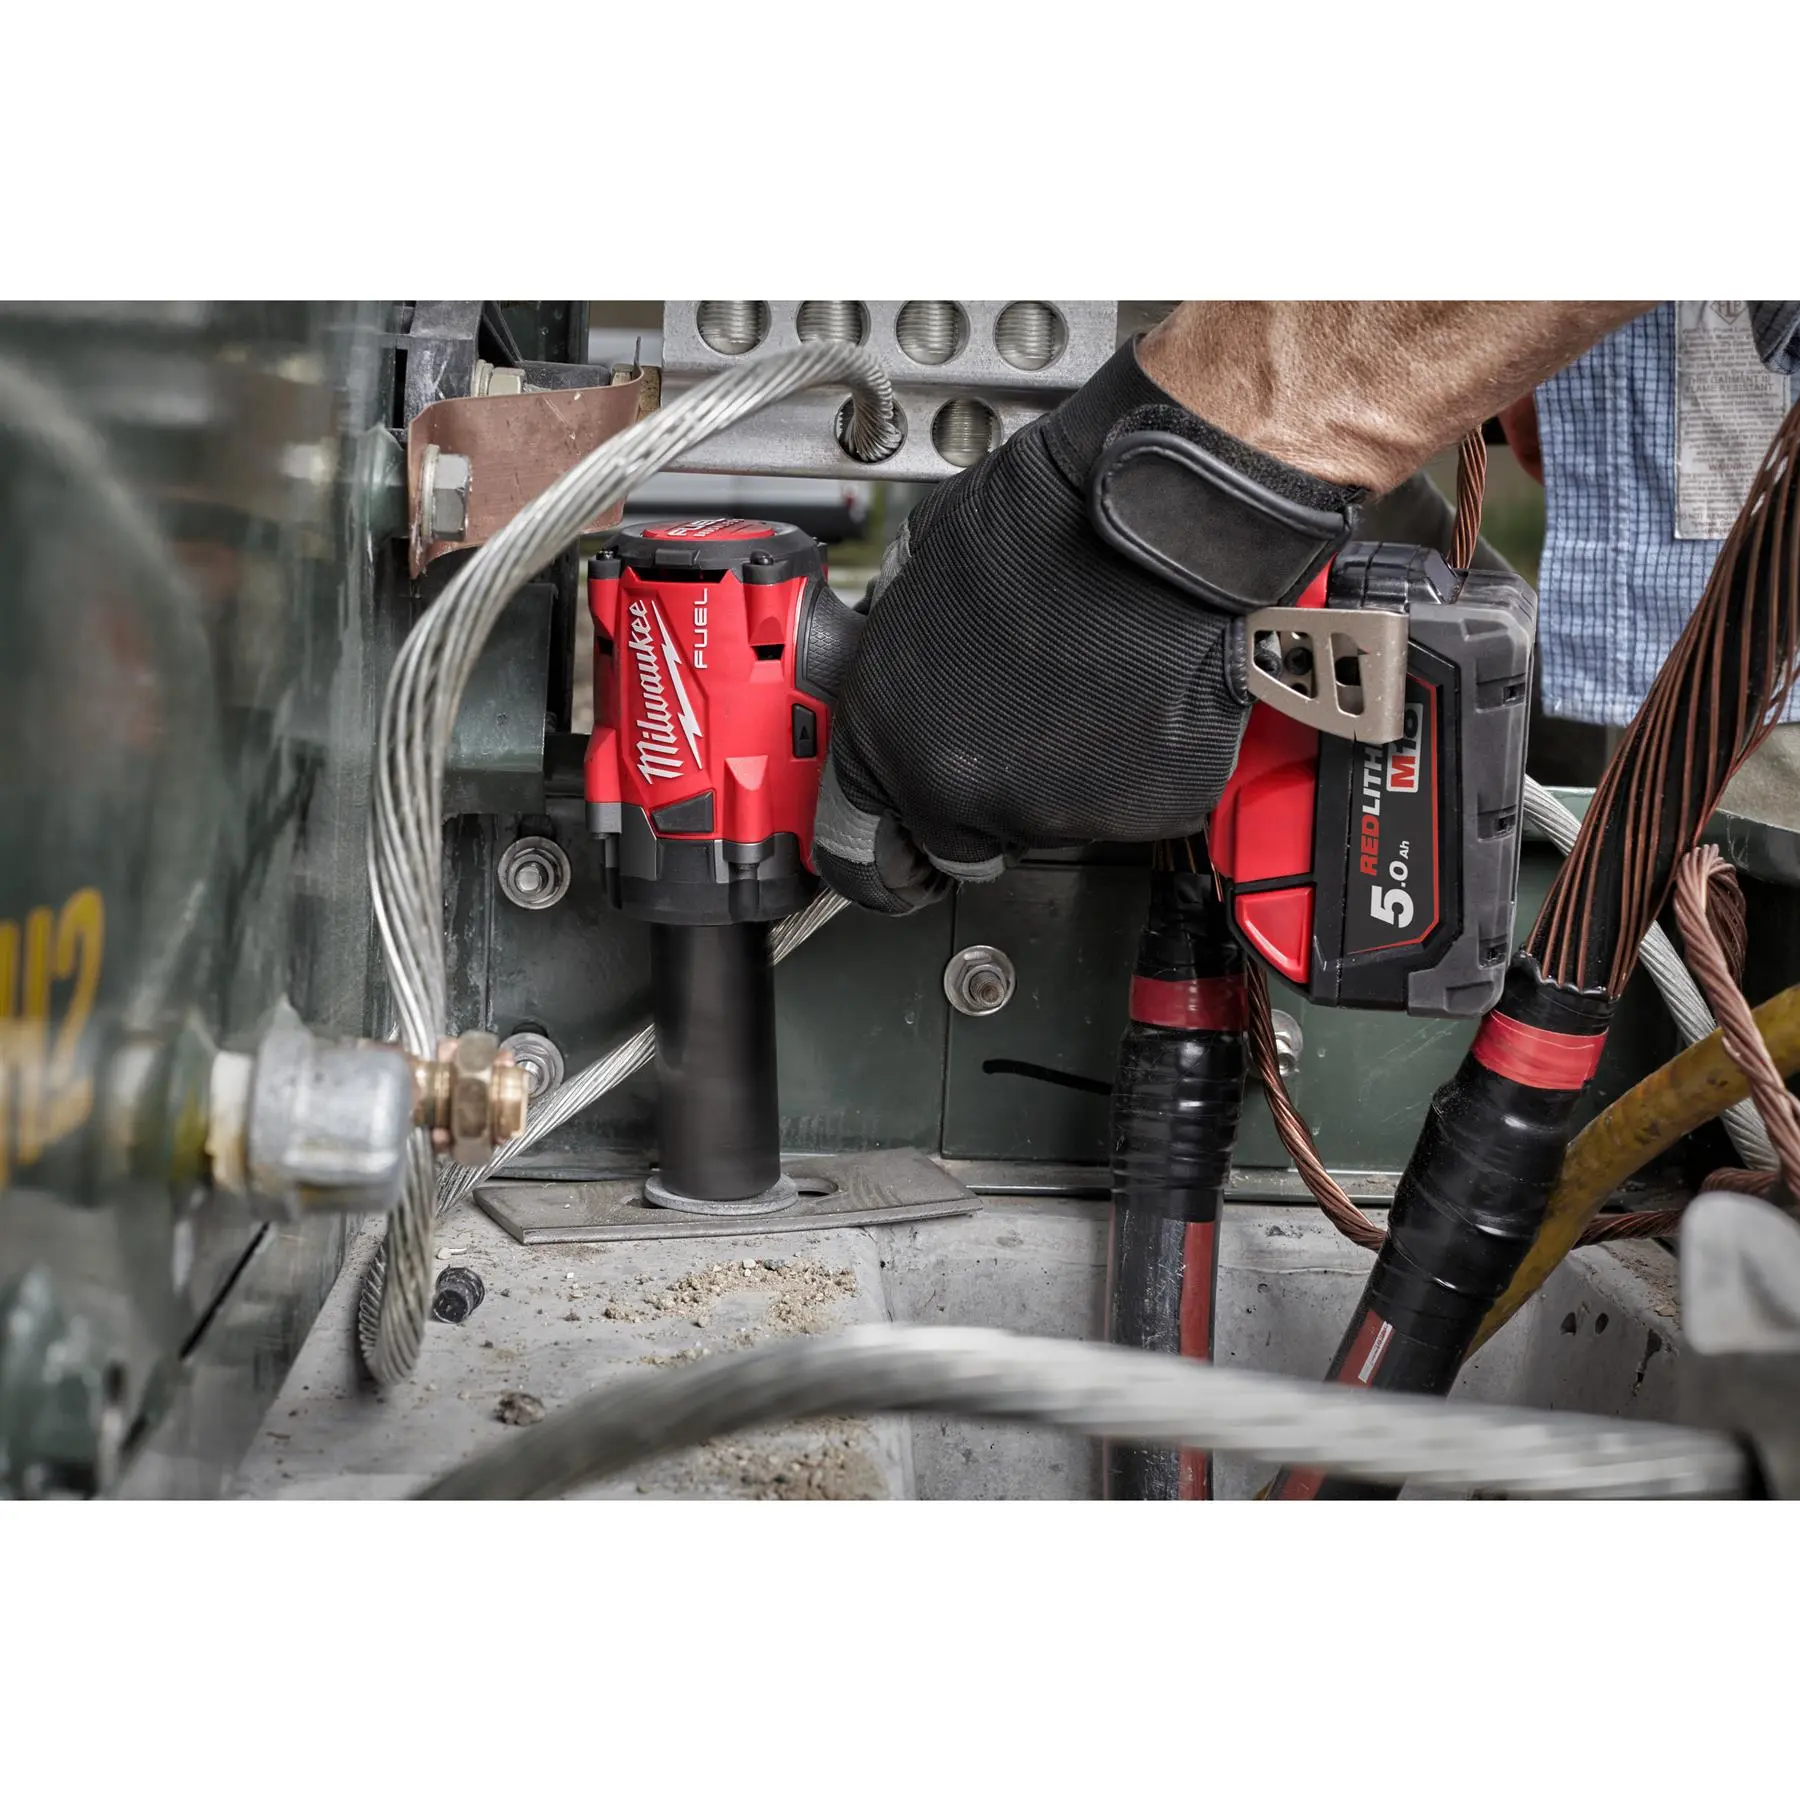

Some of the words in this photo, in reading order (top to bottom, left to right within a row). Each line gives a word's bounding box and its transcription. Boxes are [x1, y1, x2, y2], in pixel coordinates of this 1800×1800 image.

[1710, 375, 1758, 384] GARMENT
[1719, 383, 1774, 392] RESISTANT
[1708, 462, 1753, 470] WARNING
[694, 588, 708, 669] FUEL
[629, 599, 685, 785] Milwaukee
[1360, 746, 1383, 876] REDLITH
[1370, 860, 1414, 928] 5.0
[1400, 840, 1410, 860] Ah
